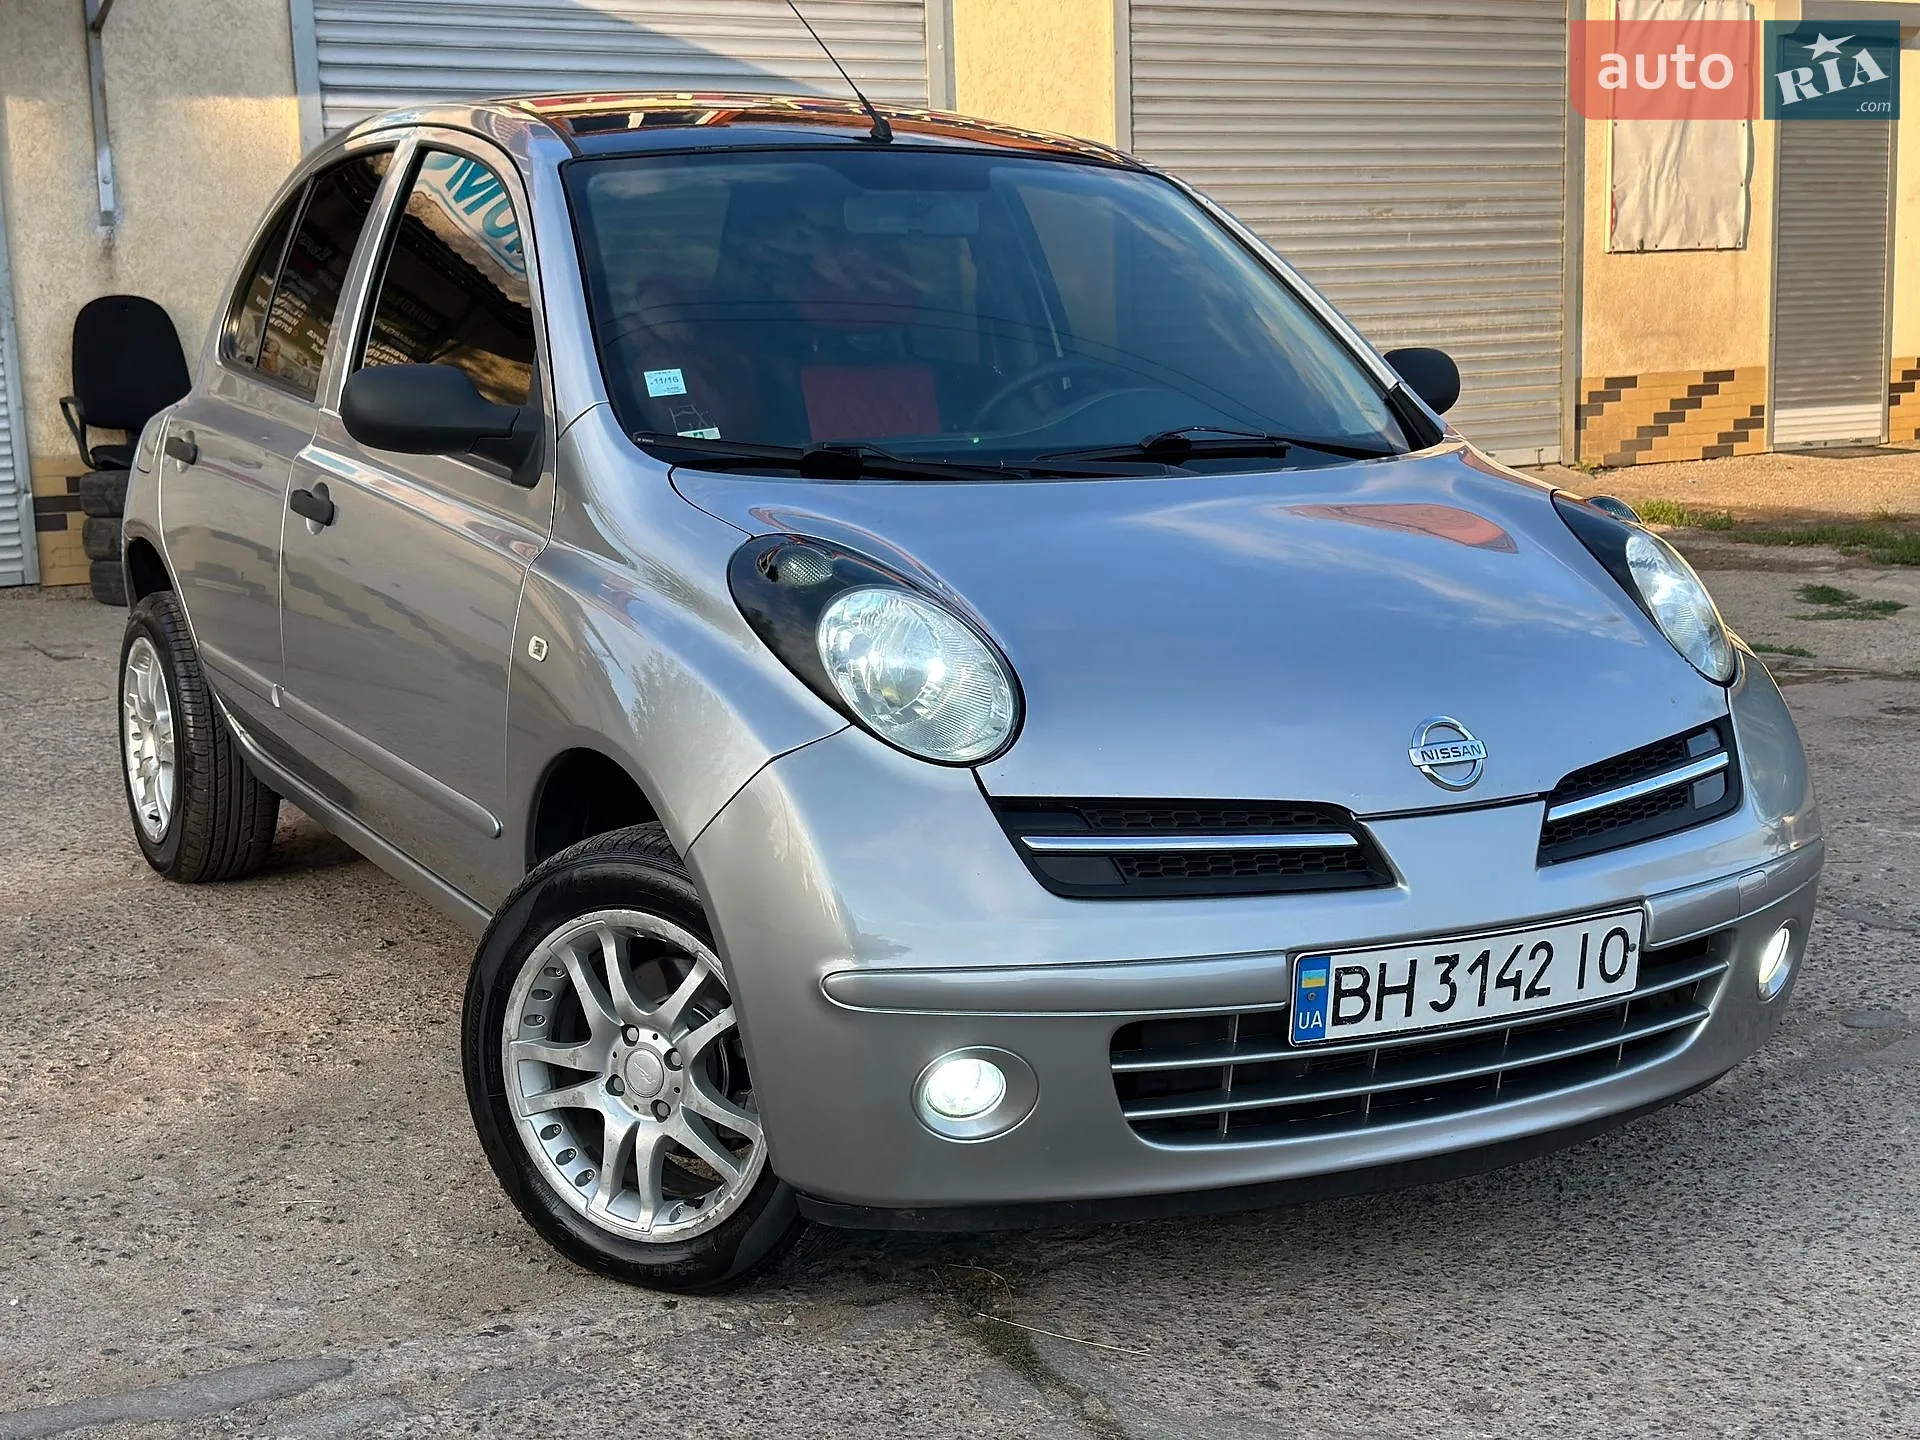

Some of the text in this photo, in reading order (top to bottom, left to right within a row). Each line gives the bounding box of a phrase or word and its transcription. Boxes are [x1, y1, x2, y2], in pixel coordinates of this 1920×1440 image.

[1420, 743, 1482, 762] NISSAN
[1577, 926, 1630, 990] IO
[1297, 1010, 1323, 1031] UA
